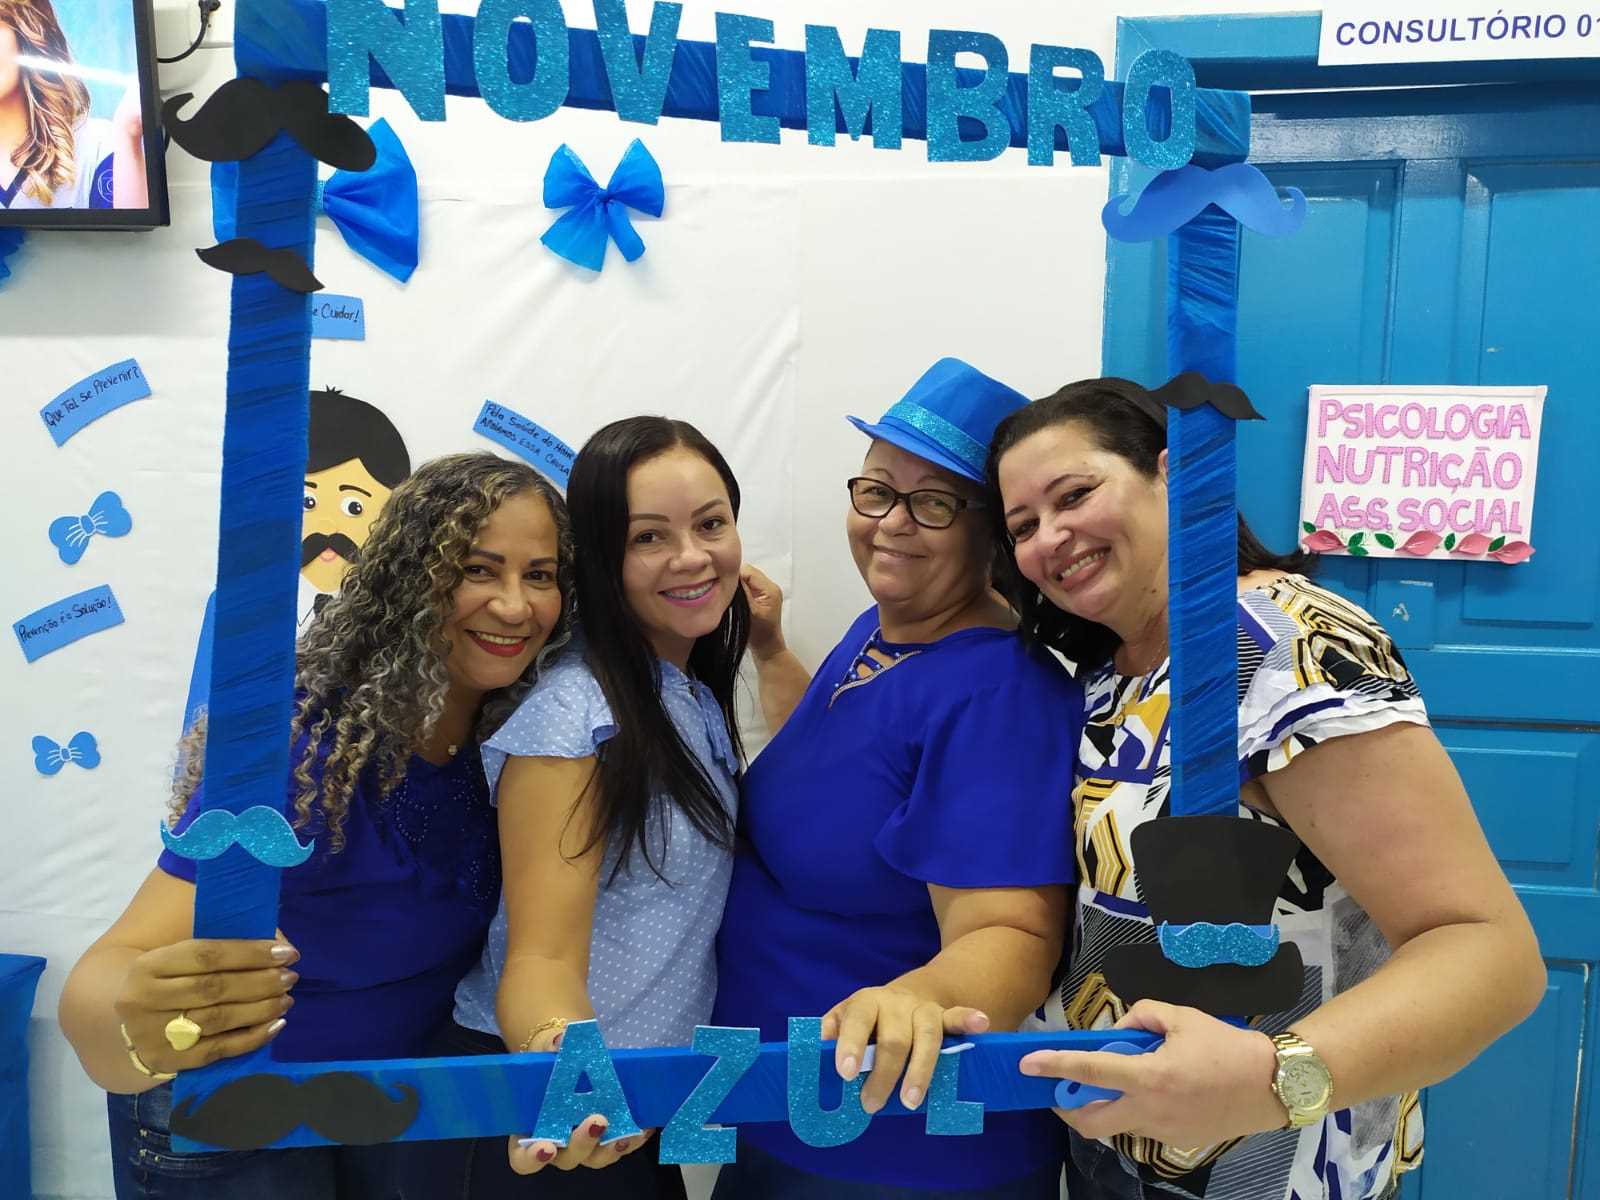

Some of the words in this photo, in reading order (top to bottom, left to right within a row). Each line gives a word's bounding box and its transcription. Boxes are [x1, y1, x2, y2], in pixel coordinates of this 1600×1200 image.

[1336, 9, 1566, 46] CONSULTÓRIO
[326, 0, 1197, 171] NOVEMBRO
[44, 409, 65, 427] Que
[1318, 399, 1531, 440] PSICOLOGIA
[1315, 444, 1522, 494] NUTRIÇÃO
[1397, 497, 1523, 534] SOCIAL
[518, 1016, 985, 1166] AZUL
